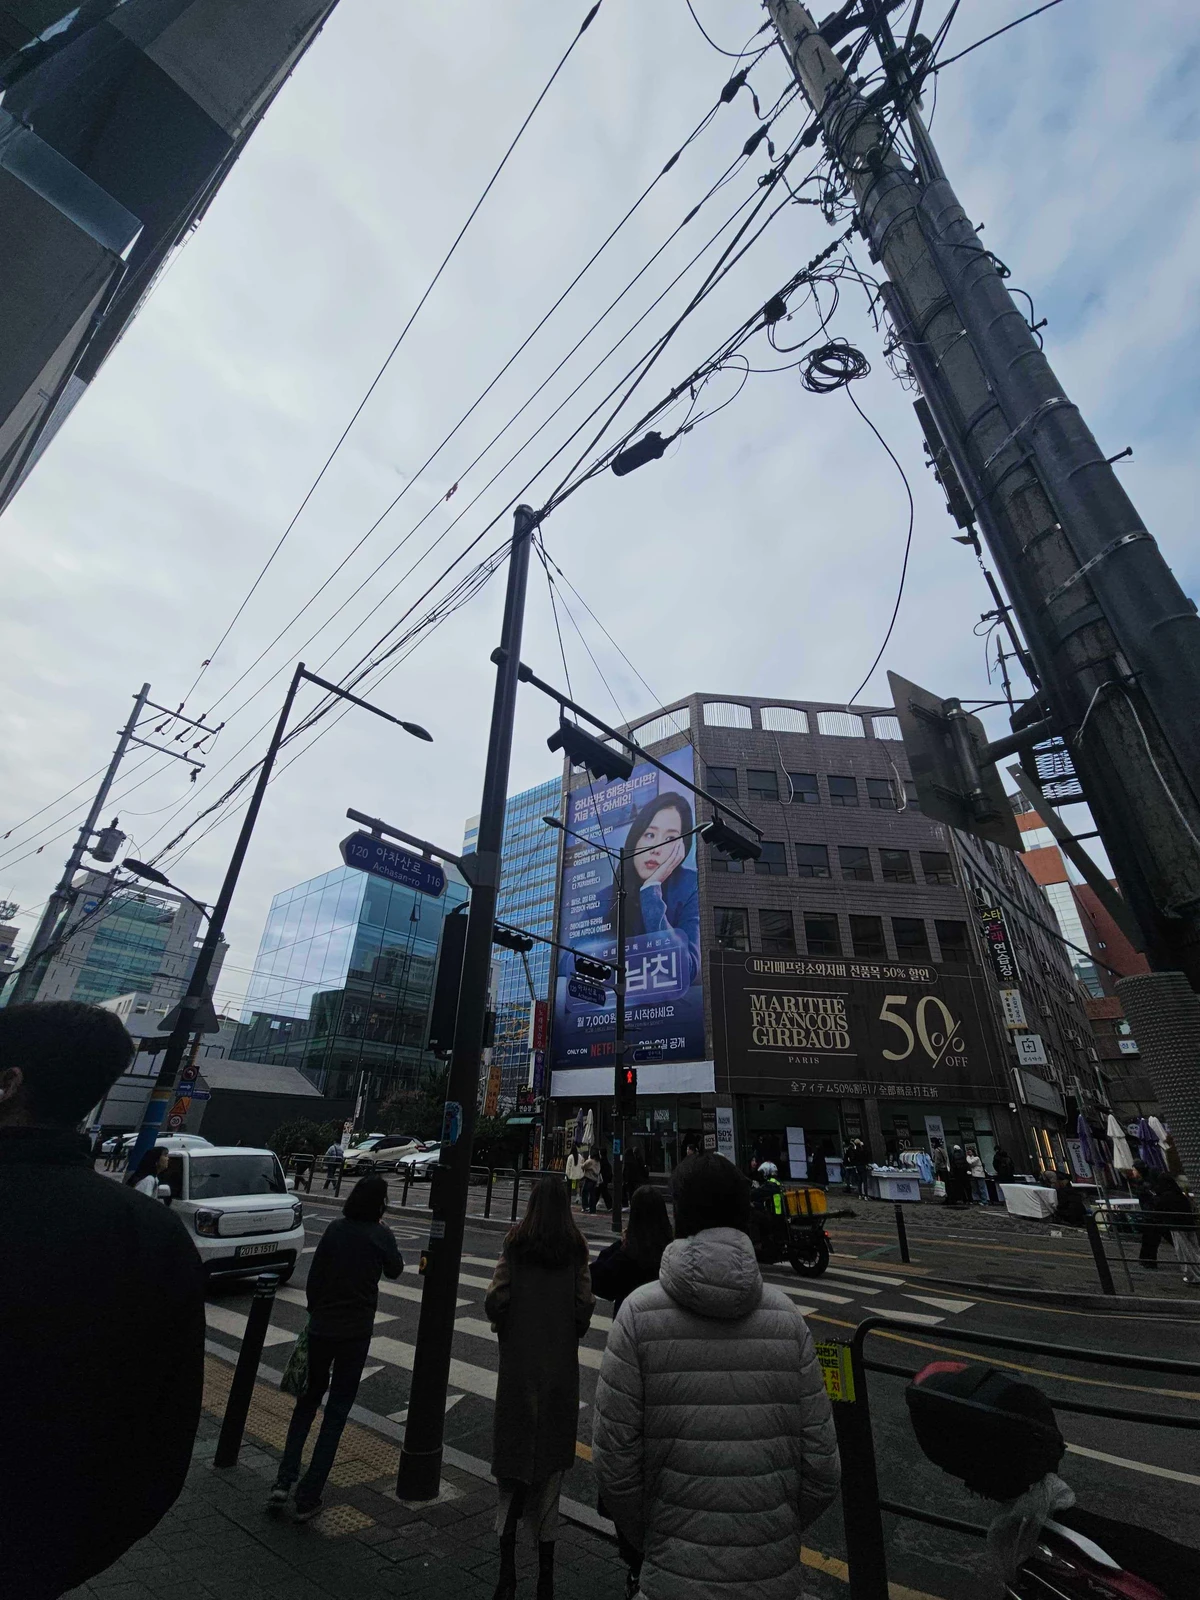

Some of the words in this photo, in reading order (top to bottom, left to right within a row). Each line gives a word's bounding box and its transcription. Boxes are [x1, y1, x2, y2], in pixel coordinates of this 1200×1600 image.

[575, 791, 605, 811] 하나라도
[606, 772, 656, 799] 해당된다면?
[573, 811, 589, 823] 지금
[602, 793, 631, 812] 하세요!
[351, 844, 369, 859] 120
[376, 847, 422, 875] 아차산로
[427, 873, 441, 888] 116
[372, 862, 420, 886] Achasan-ro
[982, 909, 1001, 921] 스타
[646, 938, 671, 948] 서비스
[850, 964, 881, 978] 전품목
[883, 966, 906, 978] 50%
[909, 969, 930, 982] 할인
[749, 994, 846, 1015] MARITHÉ
[577, 1016, 584, 1028] 월
[634, 1005, 675, 1021] 시작하세요
[669, 1037, 685, 1049] 공개
[752, 1026, 851, 1049] GIRBAUD
[567, 1048, 579, 1056] ONLY
[788, 1056, 820, 1064] PARIS
[945, 1055, 969, 1068] OFF
[879, 1085, 939, 1098] 全部商品打五折
[261, 1243, 276, 1253] 1511
